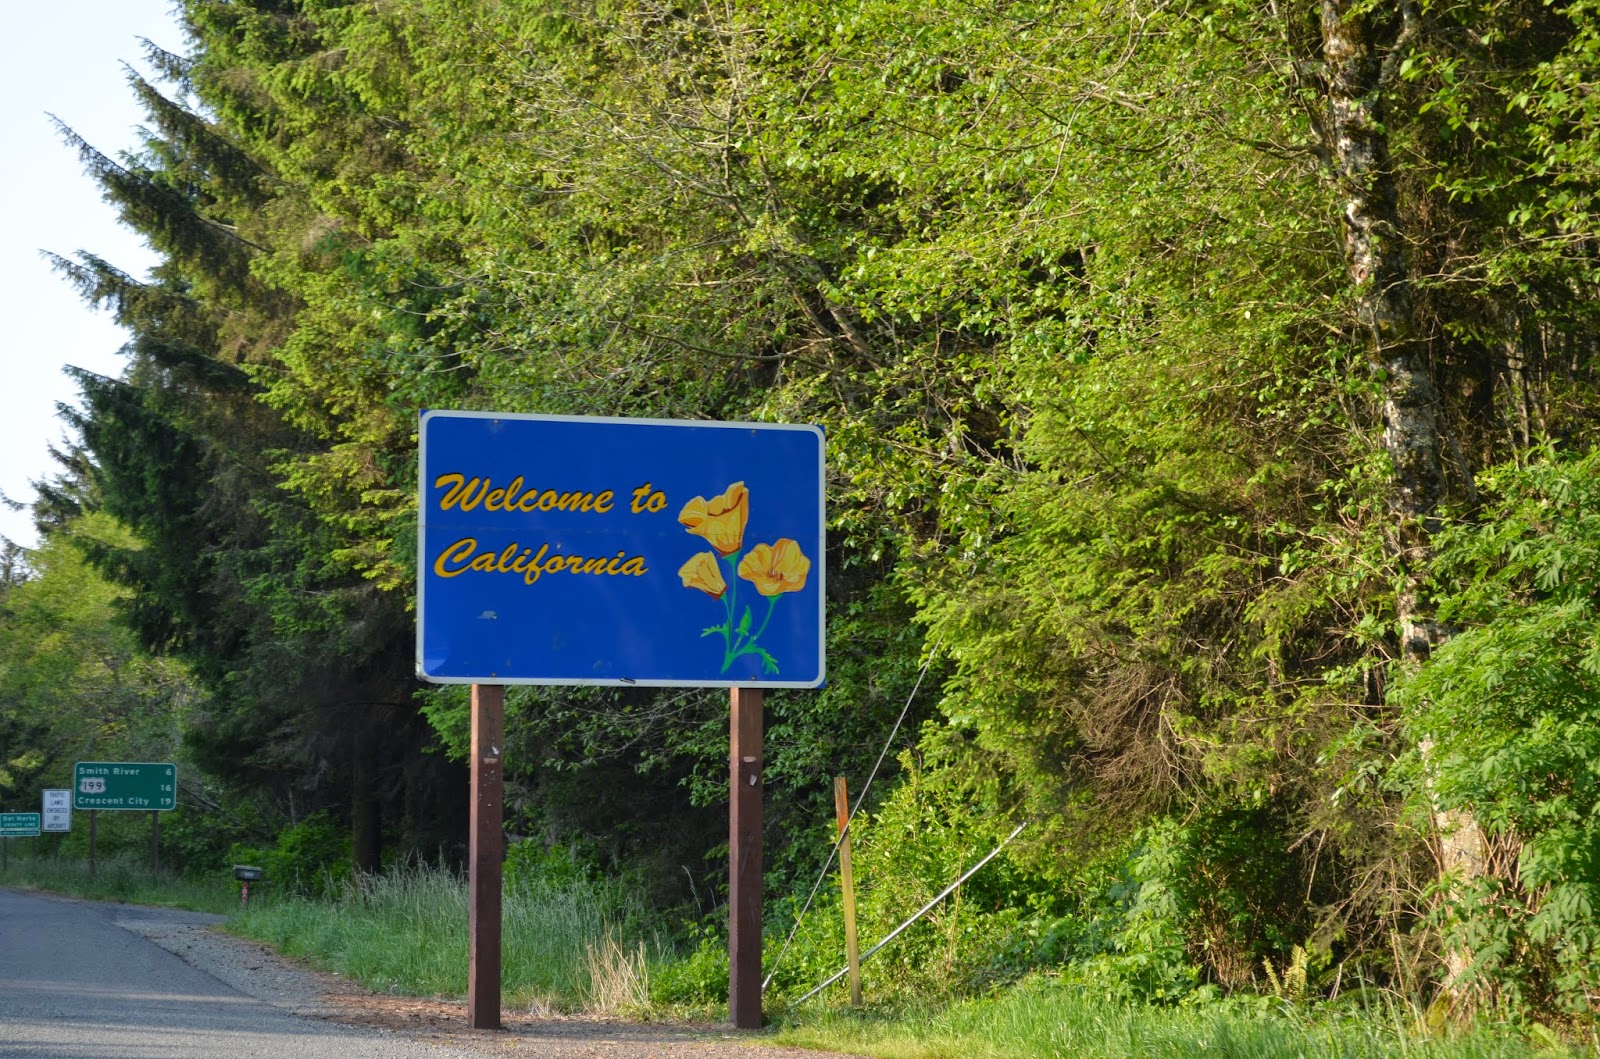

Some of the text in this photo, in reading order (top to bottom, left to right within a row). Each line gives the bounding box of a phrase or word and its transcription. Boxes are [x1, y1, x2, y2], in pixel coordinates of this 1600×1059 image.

[434, 472, 668, 514] Welcome to
[433, 537, 649, 585] California
[79, 767, 109, 775] Smith
[113, 767, 140, 775] River
[83, 781, 172, 792] 199 16
[78, 797, 124, 805] Crescent
[128, 797, 149, 806] City
